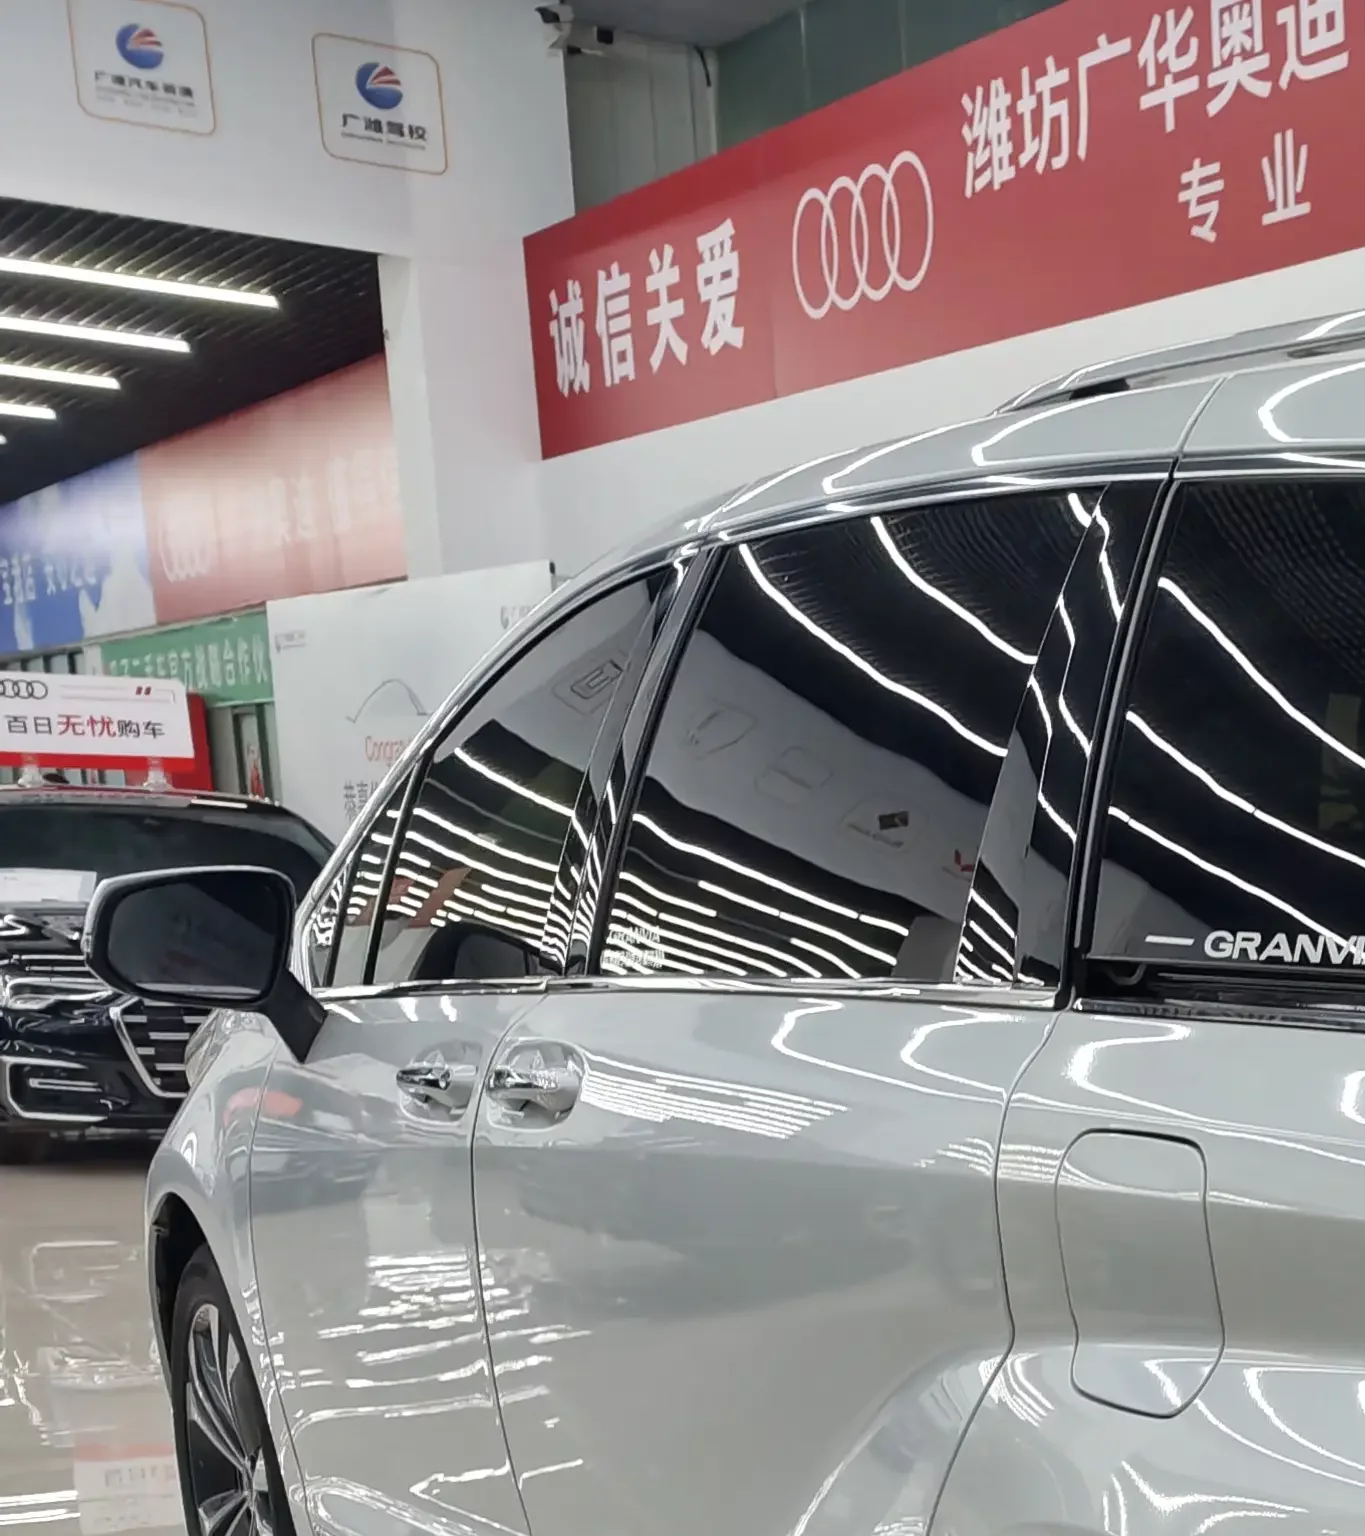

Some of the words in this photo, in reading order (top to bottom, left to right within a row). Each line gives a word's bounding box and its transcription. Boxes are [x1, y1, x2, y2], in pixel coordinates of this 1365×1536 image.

[1177, 128, 1312, 243] 专业
[548, 218, 745, 398] 诚信关爱
[4, 713, 165, 739] 百日无忧购车
